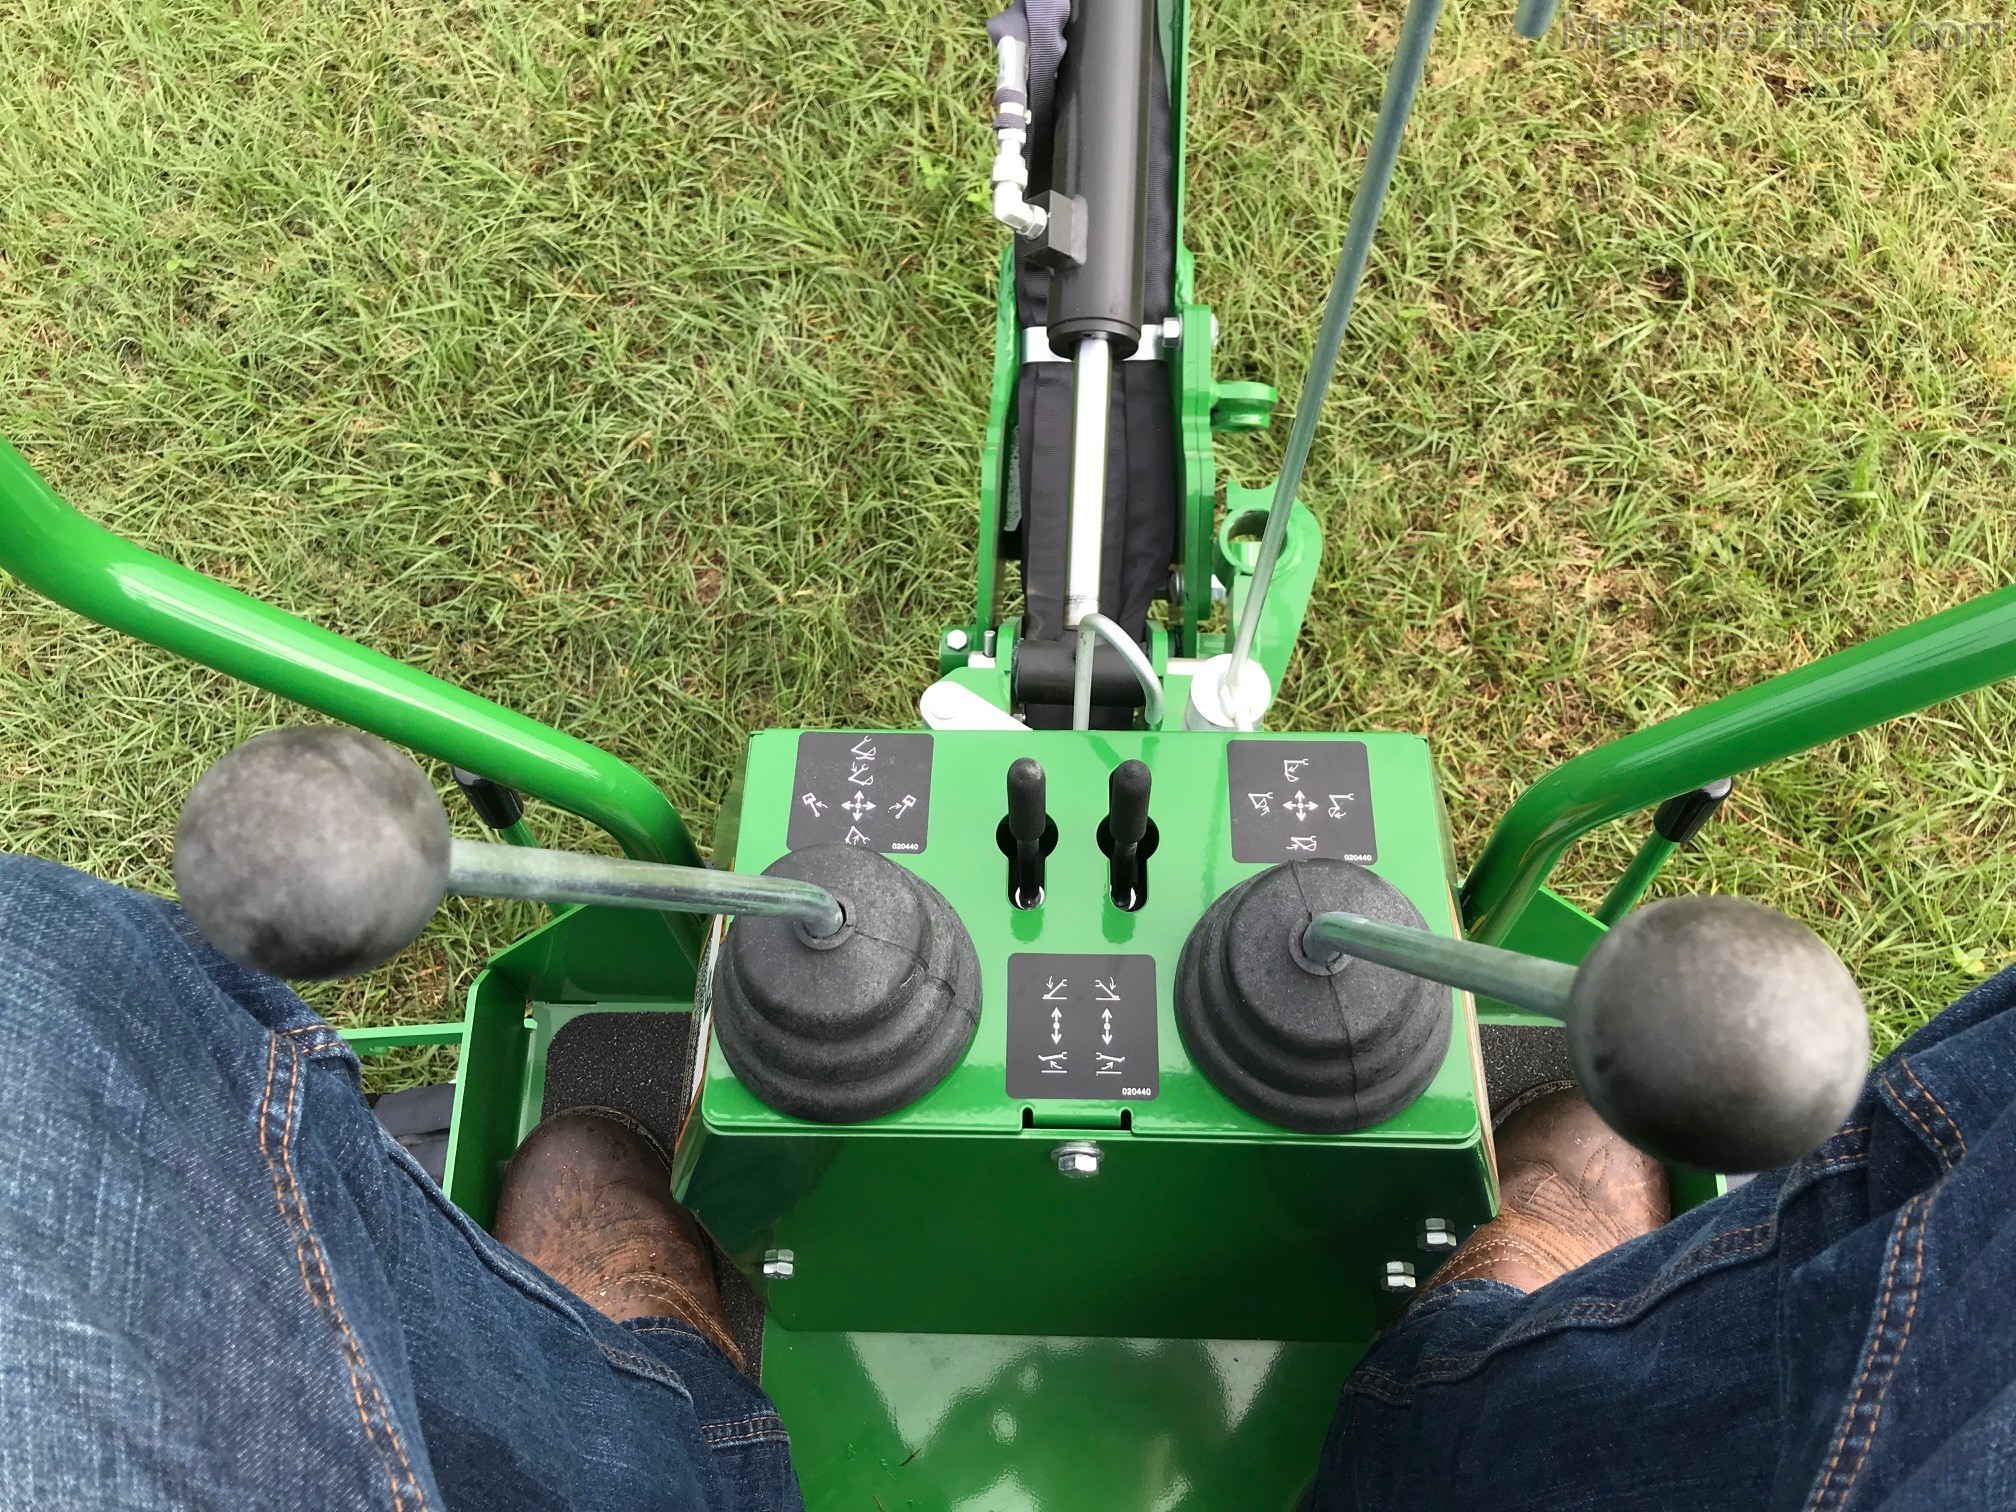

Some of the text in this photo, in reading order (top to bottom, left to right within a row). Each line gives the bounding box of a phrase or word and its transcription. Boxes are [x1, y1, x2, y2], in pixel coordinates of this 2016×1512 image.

[891, 842, 919, 850] 020440
[1343, 853, 1372, 861] 020440
[1121, 1087, 1152, 1096] 020440
